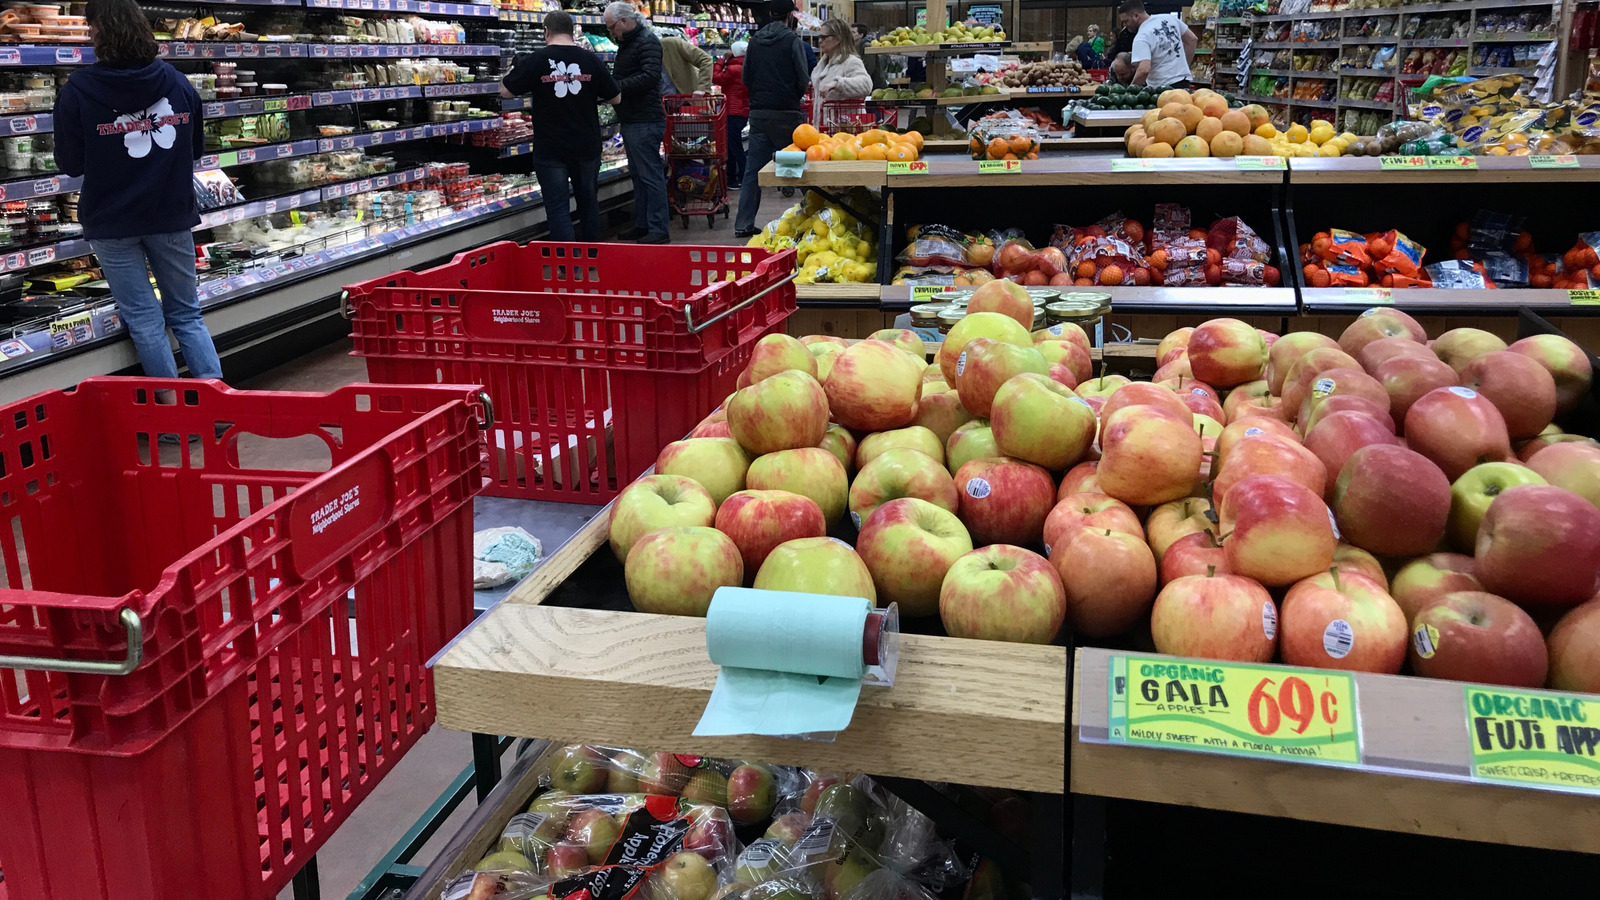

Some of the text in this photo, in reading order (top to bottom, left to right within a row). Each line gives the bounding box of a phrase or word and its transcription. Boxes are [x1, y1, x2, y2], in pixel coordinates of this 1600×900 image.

[97, 112, 190, 135] TRADER JOE'S
[311, 485, 360, 524] TRADER JOE'S
[1141, 679, 1229, 708] GALA
[1157, 703, 1205, 714] APPLES
[1166, 732, 1198, 743] SWEET
[1232, 740, 1239, 748] A
[1243, 741, 1277, 754] FLORAL
